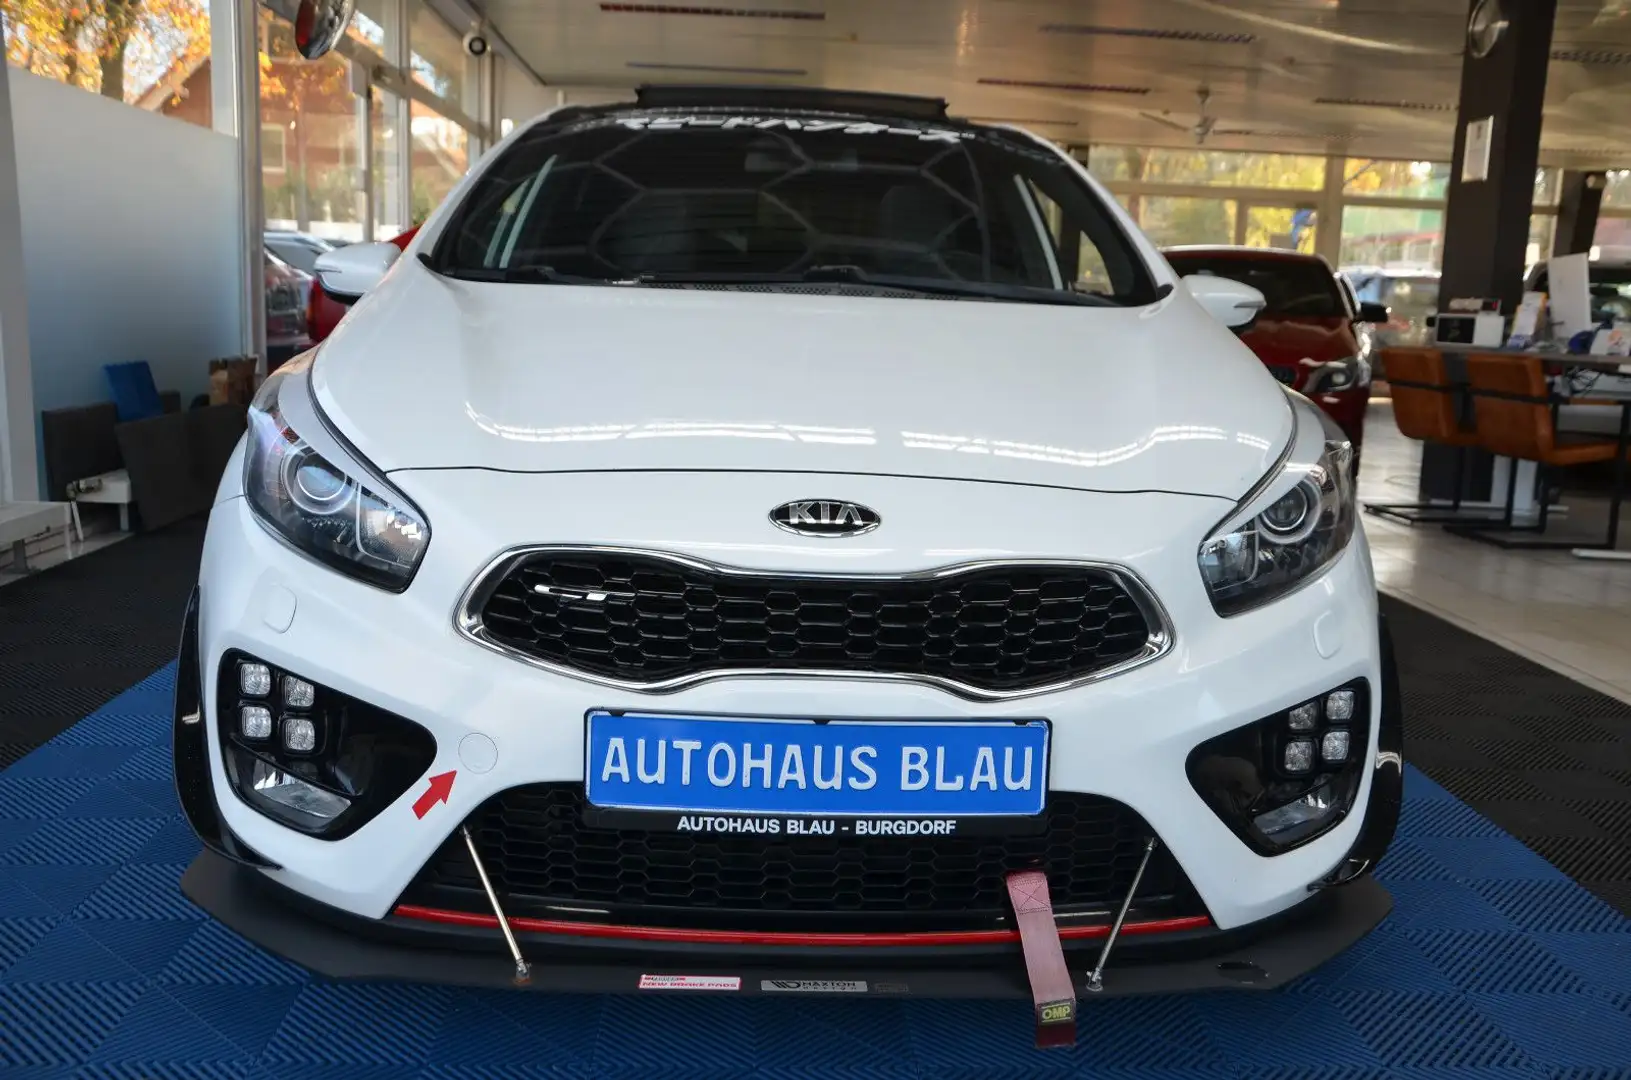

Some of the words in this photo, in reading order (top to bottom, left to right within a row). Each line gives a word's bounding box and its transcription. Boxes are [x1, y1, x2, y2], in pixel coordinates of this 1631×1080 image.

[788, 501, 864, 526] KIA
[601, 738, 878, 790] AUTOHAUS
[900, 746, 1032, 791] BLAU
[677, 816, 780, 834] AUTOHAUS
[786, 818, 835, 835] BLAU
[855, 819, 957, 836] BURGDORF
[1041, 1005, 1071, 1020] OMP
